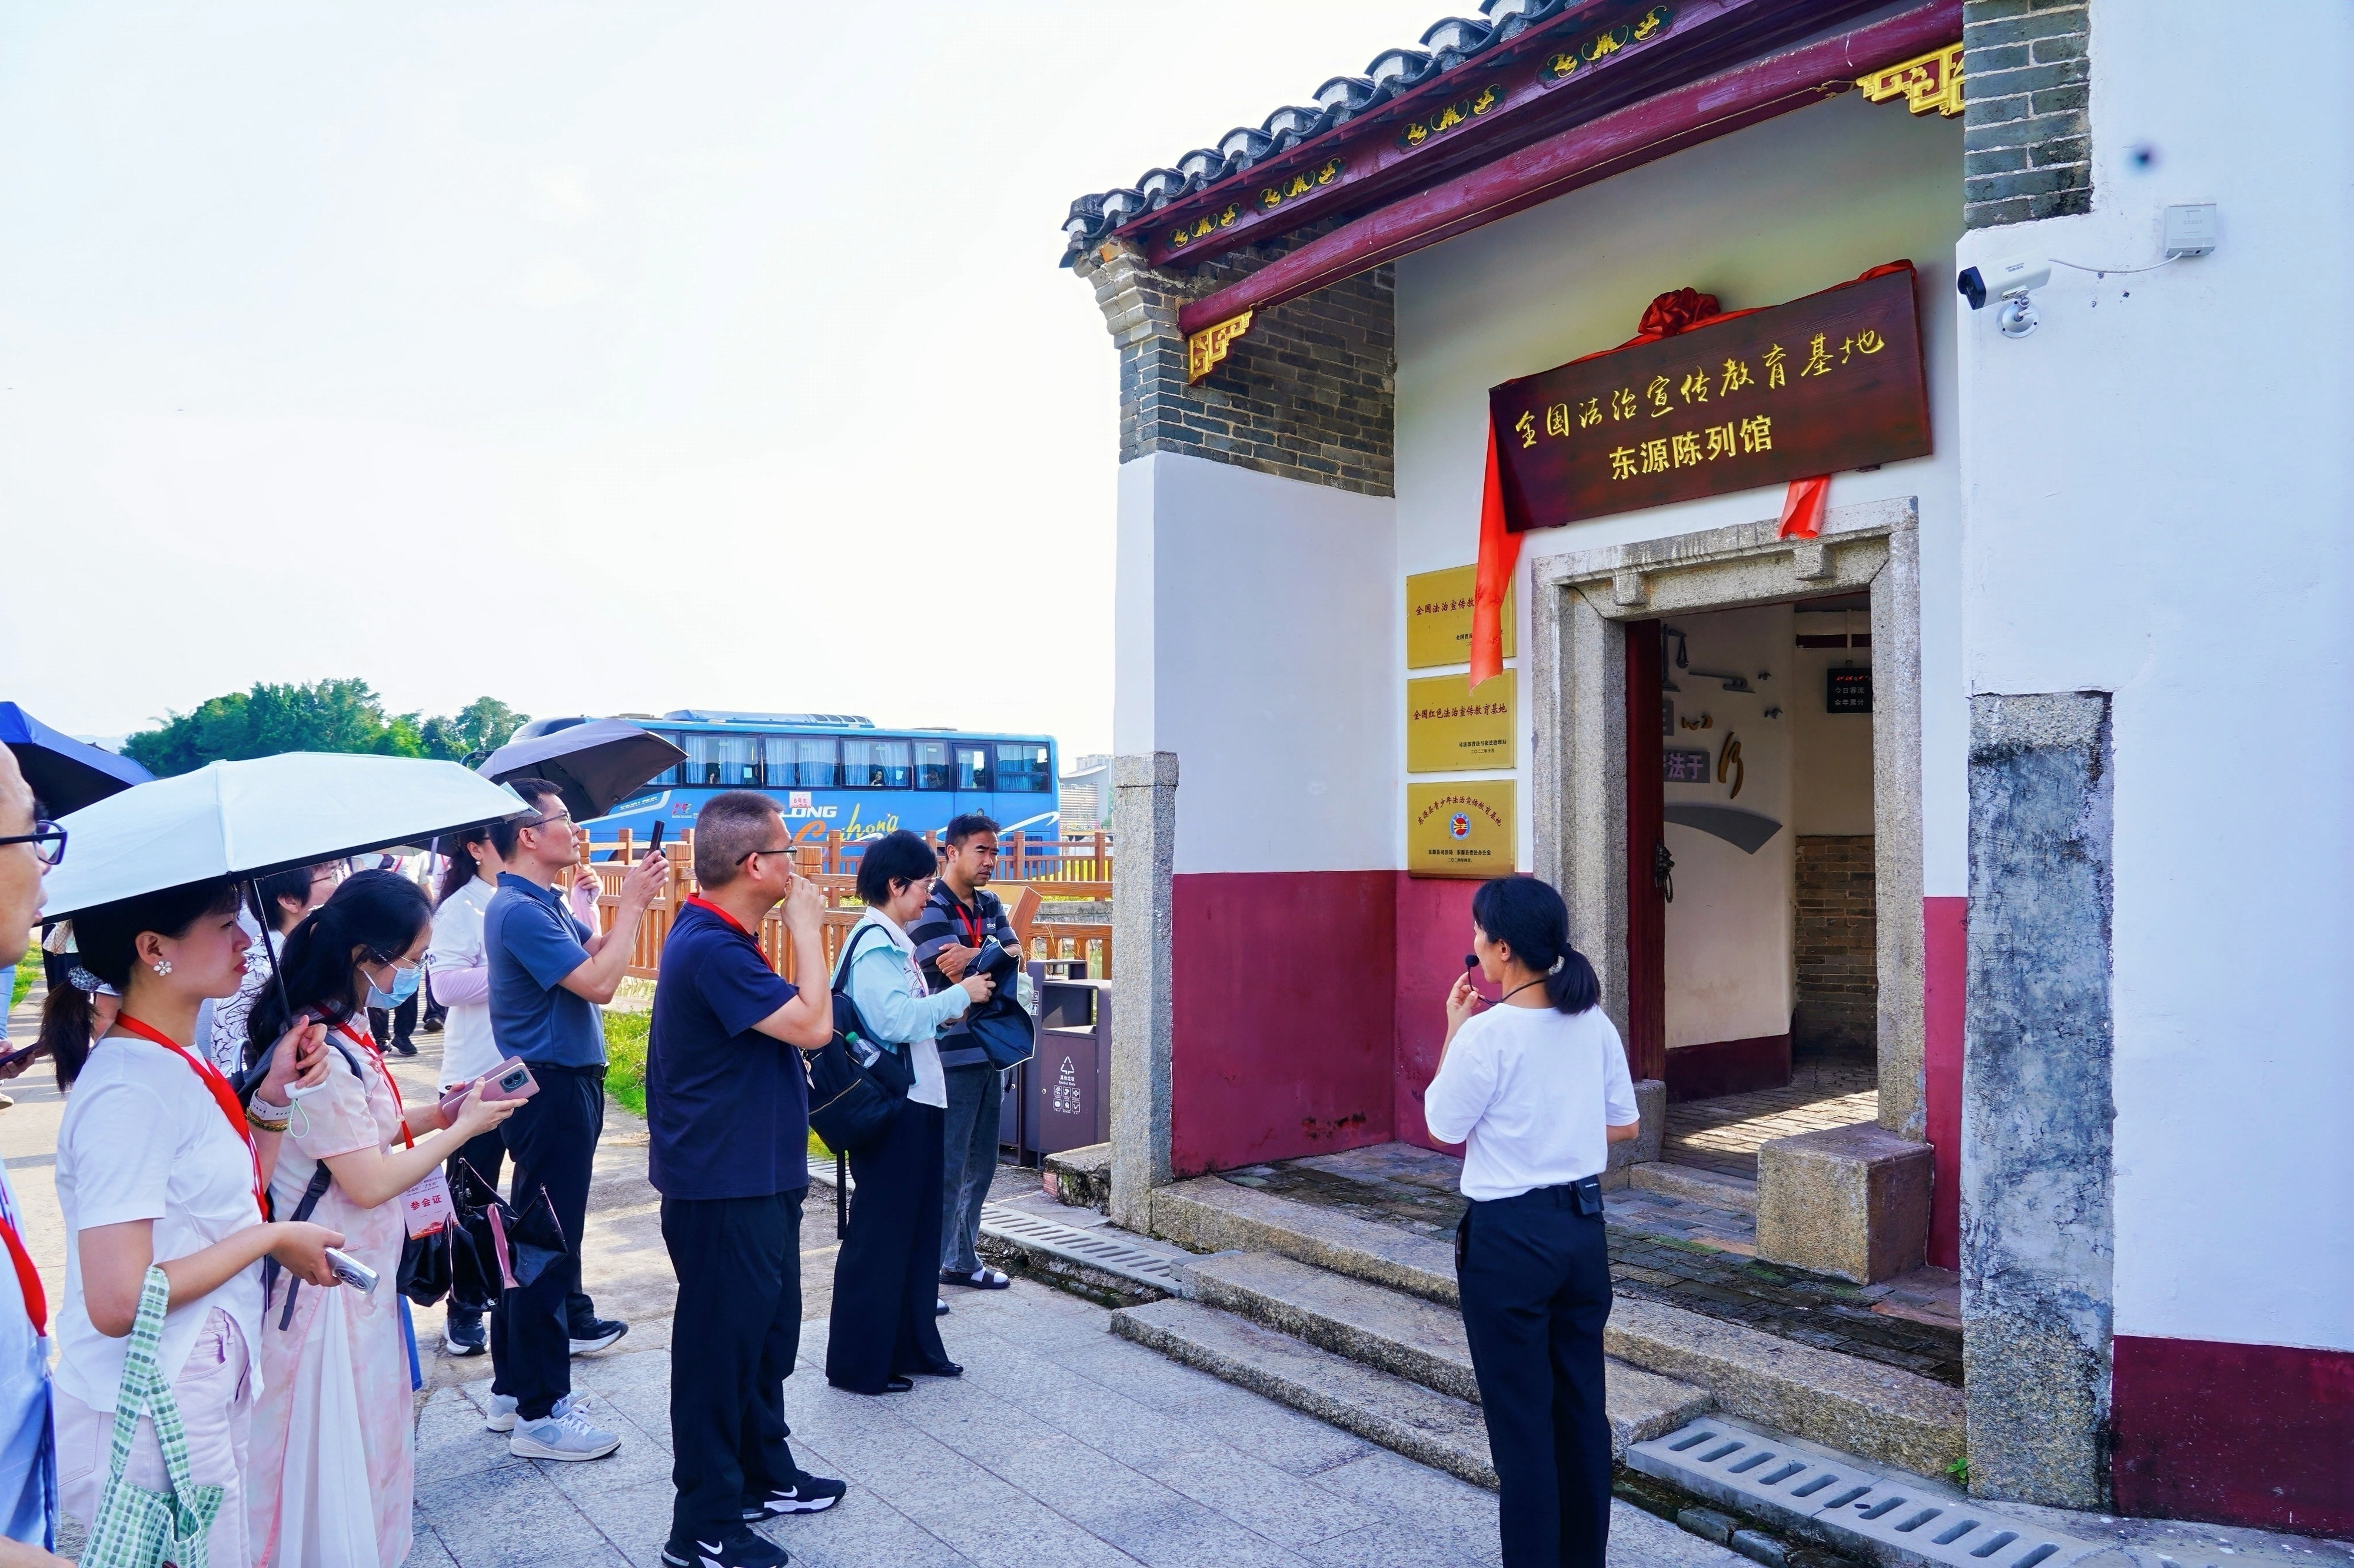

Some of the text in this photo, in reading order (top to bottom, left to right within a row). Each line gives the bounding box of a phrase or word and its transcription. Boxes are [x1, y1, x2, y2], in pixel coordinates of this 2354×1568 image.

[1515, 328, 1884, 448] 全国法治宣传教育基地
[1609, 415, 1773, 481] 东源陈列馆
[1413, 703, 1507, 720] 全国红色法治宣传教育基地
[1663, 753, 1704, 780] 法于
[1418, 795, 1501, 827] 东源县青少年法治宣传教育基地
[410, 1194, 442, 1211] 参会证
